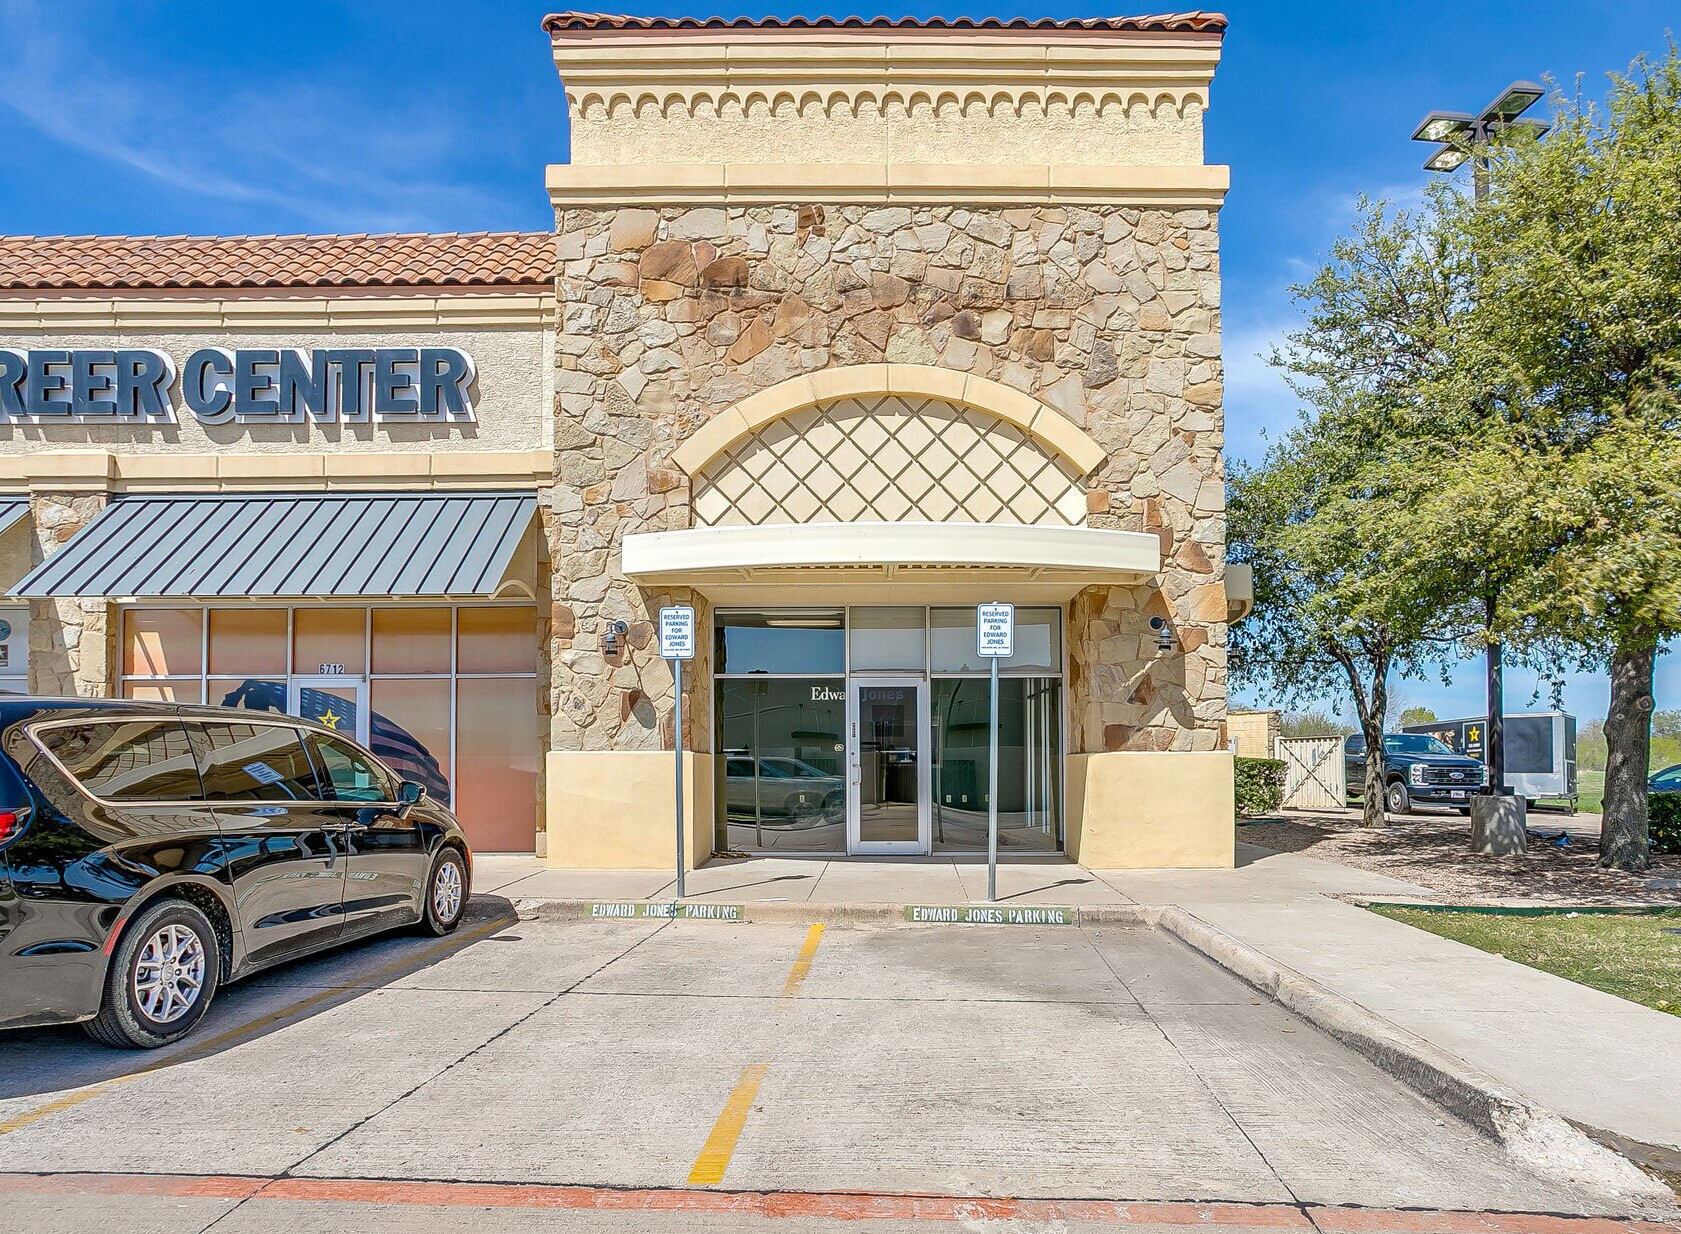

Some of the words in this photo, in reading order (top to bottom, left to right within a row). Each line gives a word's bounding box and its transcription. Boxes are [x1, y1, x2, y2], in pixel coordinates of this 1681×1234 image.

[183, 348, 474, 422] CENTER
[320, 664, 344, 674] 6712
[811, 686, 846, 700] Edwa
[592, 904, 635, 917] EDWARD
[642, 904, 678, 917] JONES
[685, 905, 737, 919] PARKING
[913, 907, 958, 922] EDWARD
[965, 909, 1003, 923] JONES
[1008, 910, 1064, 924] PARKING
